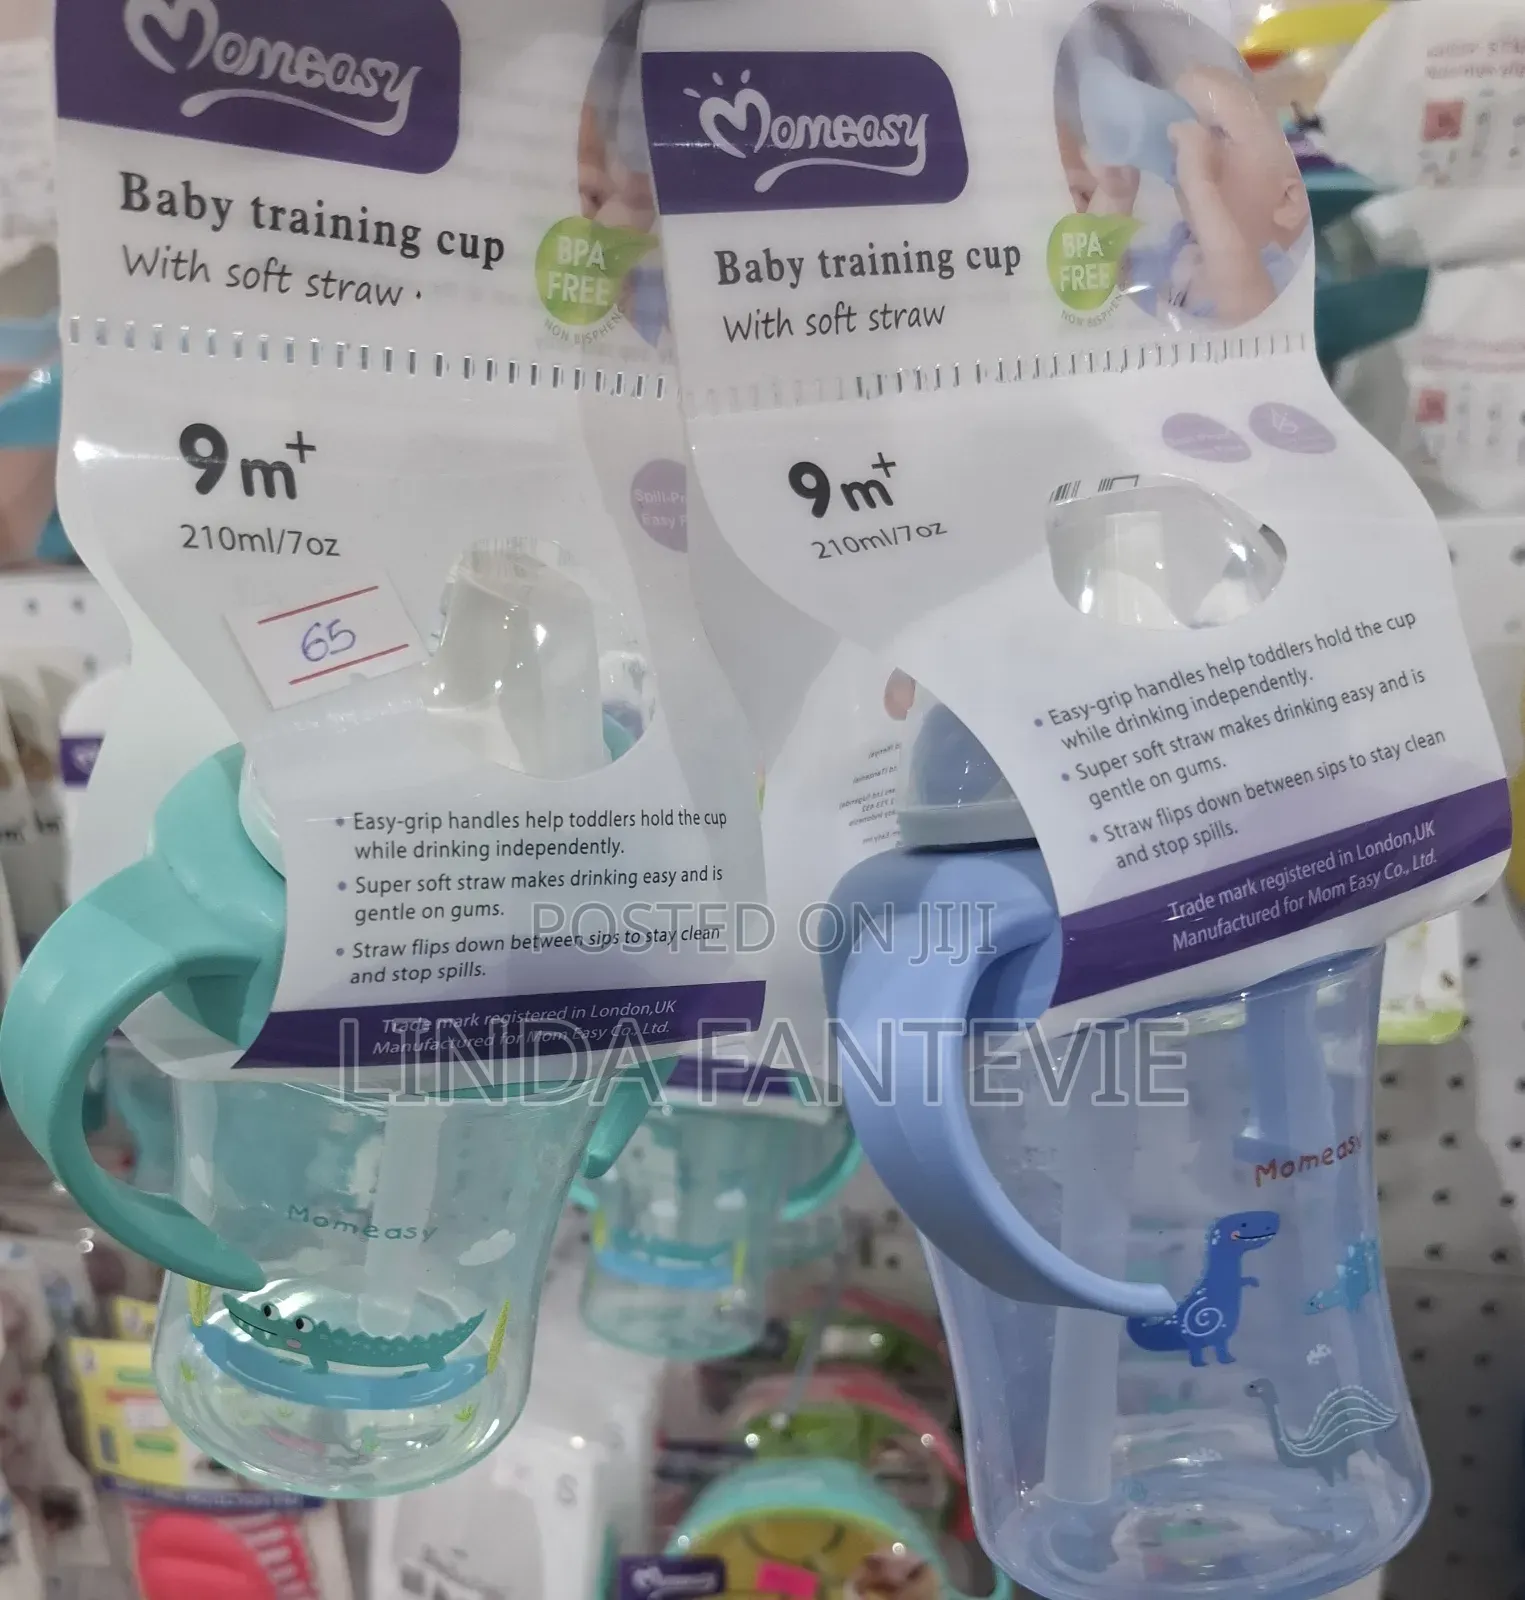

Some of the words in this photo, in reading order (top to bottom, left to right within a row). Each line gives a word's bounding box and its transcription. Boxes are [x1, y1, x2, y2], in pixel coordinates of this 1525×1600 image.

[123, 0, 423, 136] Momeasy
[698, 87, 930, 193] Momeasy
[119, 171, 234, 232] Baby
[252, 200, 421, 260] training
[436, 230, 505, 269] cup
[557, 235, 607, 271] BPA
[1062, 231, 1104, 258] BPA
[122, 244, 210, 284] With
[226, 257, 291, 294] soft
[306, 269, 404, 306] straw
[714, 249, 804, 289] Baby
[818, 241, 953, 280] training
[966, 243, 1021, 277] cup
[1060, 263, 1111, 291] FREE
[547, 271, 611, 306] FREE
[723, 307, 794, 343] With
[805, 302, 857, 337] soft
[869, 299, 945, 334] straw
[180, 524, 341, 556] 210ml/7oz
[641, 512, 675, 530] Easy
[811, 522, 947, 559] 210ml/7oz
[301, 619, 357, 662] 65
[1047, 690, 1133, 727] Easy-grip
[1134, 669, 1205, 700] handles
[1206, 657, 1245, 679] help
[1248, 638, 1314, 668] toddlers
[1314, 628, 1352, 650] hold
[1355, 621, 1383, 642] the
[1386, 612, 1417, 635] cup
[1061, 724, 1112, 751] while
[1115, 700, 1189, 734] drinking
[1191, 668, 1313, 713] independently.
[1075, 754, 1128, 783] Super
[1133, 741, 1167, 762] soft
[1169, 730, 1215, 755] straw
[1219, 713, 1271, 740] makes
[1274, 694, 1339, 724] drinking
[1341, 684, 1375, 706] easy
[1379, 672, 1409, 694] and
[1412, 668, 1426, 685] is
[1089, 778, 1146, 810] gentle
[1150, 772, 1173, 790] on
[1176, 754, 1227, 783] gums.
[1103, 816, 1153, 843] Straw
[1156, 800, 1193, 828] flips
[1196, 789, 1242, 815] down
[1244, 771, 1313, 801] between
[1317, 760, 1347, 782] sips
[1350, 753, 1367, 769] to
[1370, 742, 1401, 764] stay
[1404, 729, 1446, 752] clean
[354, 812, 442, 834] Easy-grip
[449, 812, 520, 829] handles
[526, 811, 564, 831] help
[569, 811, 636, 828] toddlers
[641, 809, 674, 827] hold
[678, 809, 700, 826] the
[704, 812, 727, 831] cup
[355, 840, 407, 860] while
[413, 840, 489, 861] drinking
[496, 838, 624, 860] independently.
[1115, 847, 1147, 870] and
[1151, 835, 1189, 857] stop
[1195, 819, 1239, 846] spills.
[355, 876, 411, 897] Super
[417, 874, 451, 892] soft
[458, 874, 505, 890] straw
[511, 870, 565, 889] makes
[570, 868, 638, 889] drinking
[642, 870, 676, 887] easy
[681, 866, 708, 883] and
[712, 865, 723, 881] is
[1167, 896, 1216, 919] Trade
[1219, 884, 1257, 906] mark
[1260, 851, 1336, 895] registered
[1338, 849, 1354, 865] in
[1356, 820, 1436, 861] London,UK
[355, 902, 415, 926] gentle
[422, 904, 444, 919] on
[451, 901, 504, 922] gums.
[1172, 904, 1281, 952] Manufactured
[1283, 894, 1305, 914] for
[1307, 884, 1346, 906] Mom
[1350, 870, 1381, 895] Easy
[1412, 848, 1437, 868] Ltd.
[352, 941, 406, 959] Straw
[411, 938, 450, 958] flips
[456, 937, 504, 954] down
[511, 933, 582, 951] between
[589, 930, 619, 949] sips
[624, 929, 640, 945] to
[645, 928, 677, 946] stay
[680, 925, 720, 941] clean
[350, 966, 385, 985] and
[392, 965, 432, 985] stop
[437, 961, 486, 982] spills.
[382, 1018, 430, 1034] Trade
[437, 1013, 479, 1030] mark
[484, 1006, 568, 1028] registered
[571, 1005, 586, 1019] in
[590, 999, 676, 1019] London,UK
[373, 1036, 494, 1055] Manufactured
[500, 1033, 524, 1047] for
[526, 1029, 568, 1044] Mom
[572, 1026, 607, 1043] Easy
[642, 1021, 670, 1035] Ltd.
[288, 1204, 438, 1243] Momeasy
